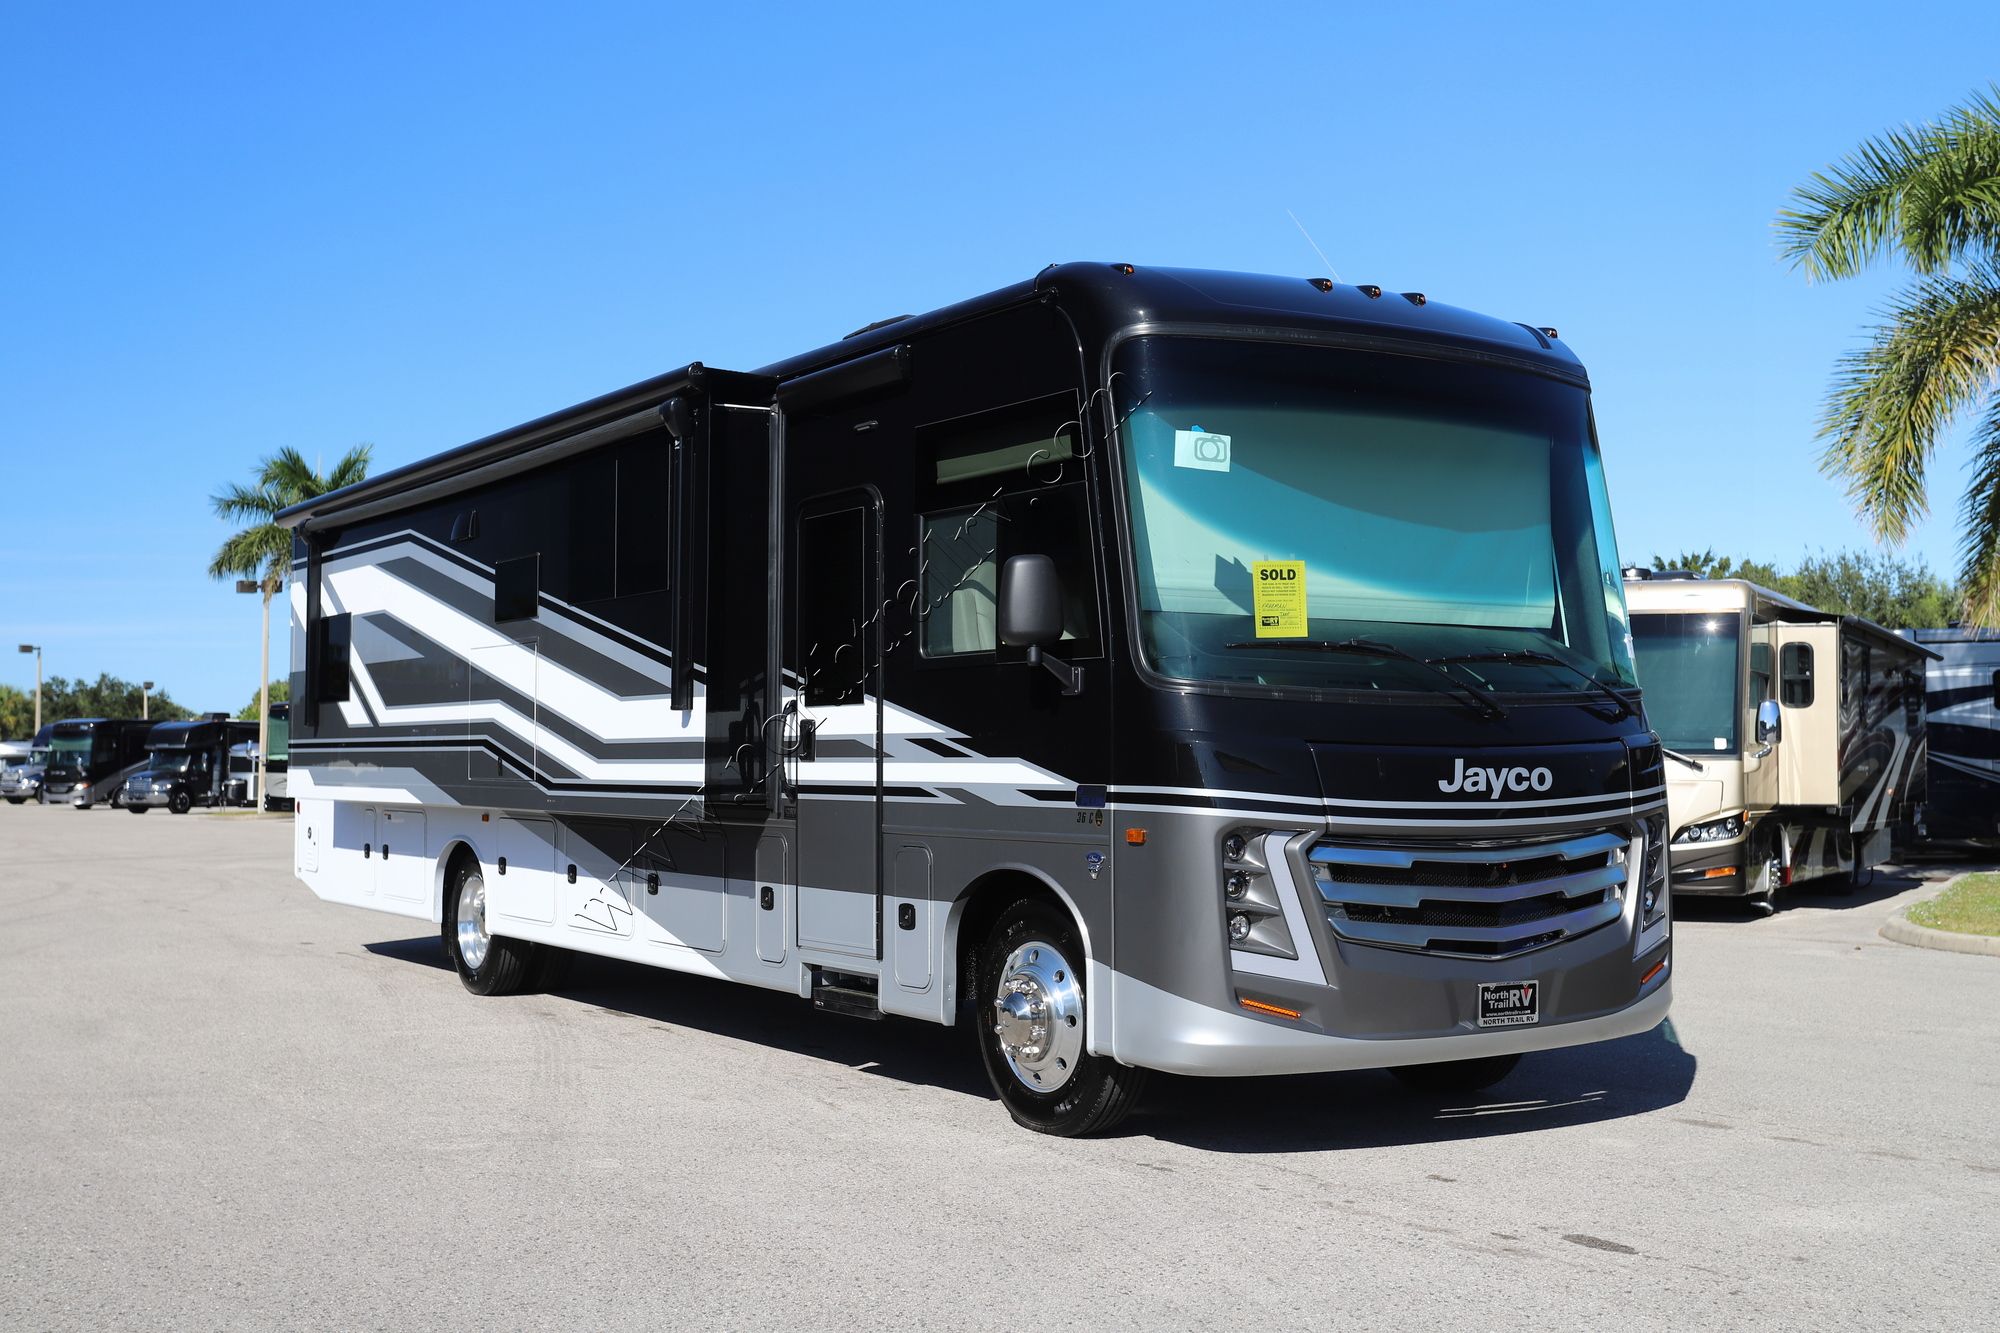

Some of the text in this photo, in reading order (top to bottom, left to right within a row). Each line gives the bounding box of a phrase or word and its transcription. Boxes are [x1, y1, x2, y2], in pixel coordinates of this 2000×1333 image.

[1260, 569, 1296, 580] SOLD
[1438, 758, 1553, 799] Jayco
[1484, 990, 1509, 1000] North
[1509, 988, 1533, 1007] RV
[1488, 1000, 1509, 1009] Trail
